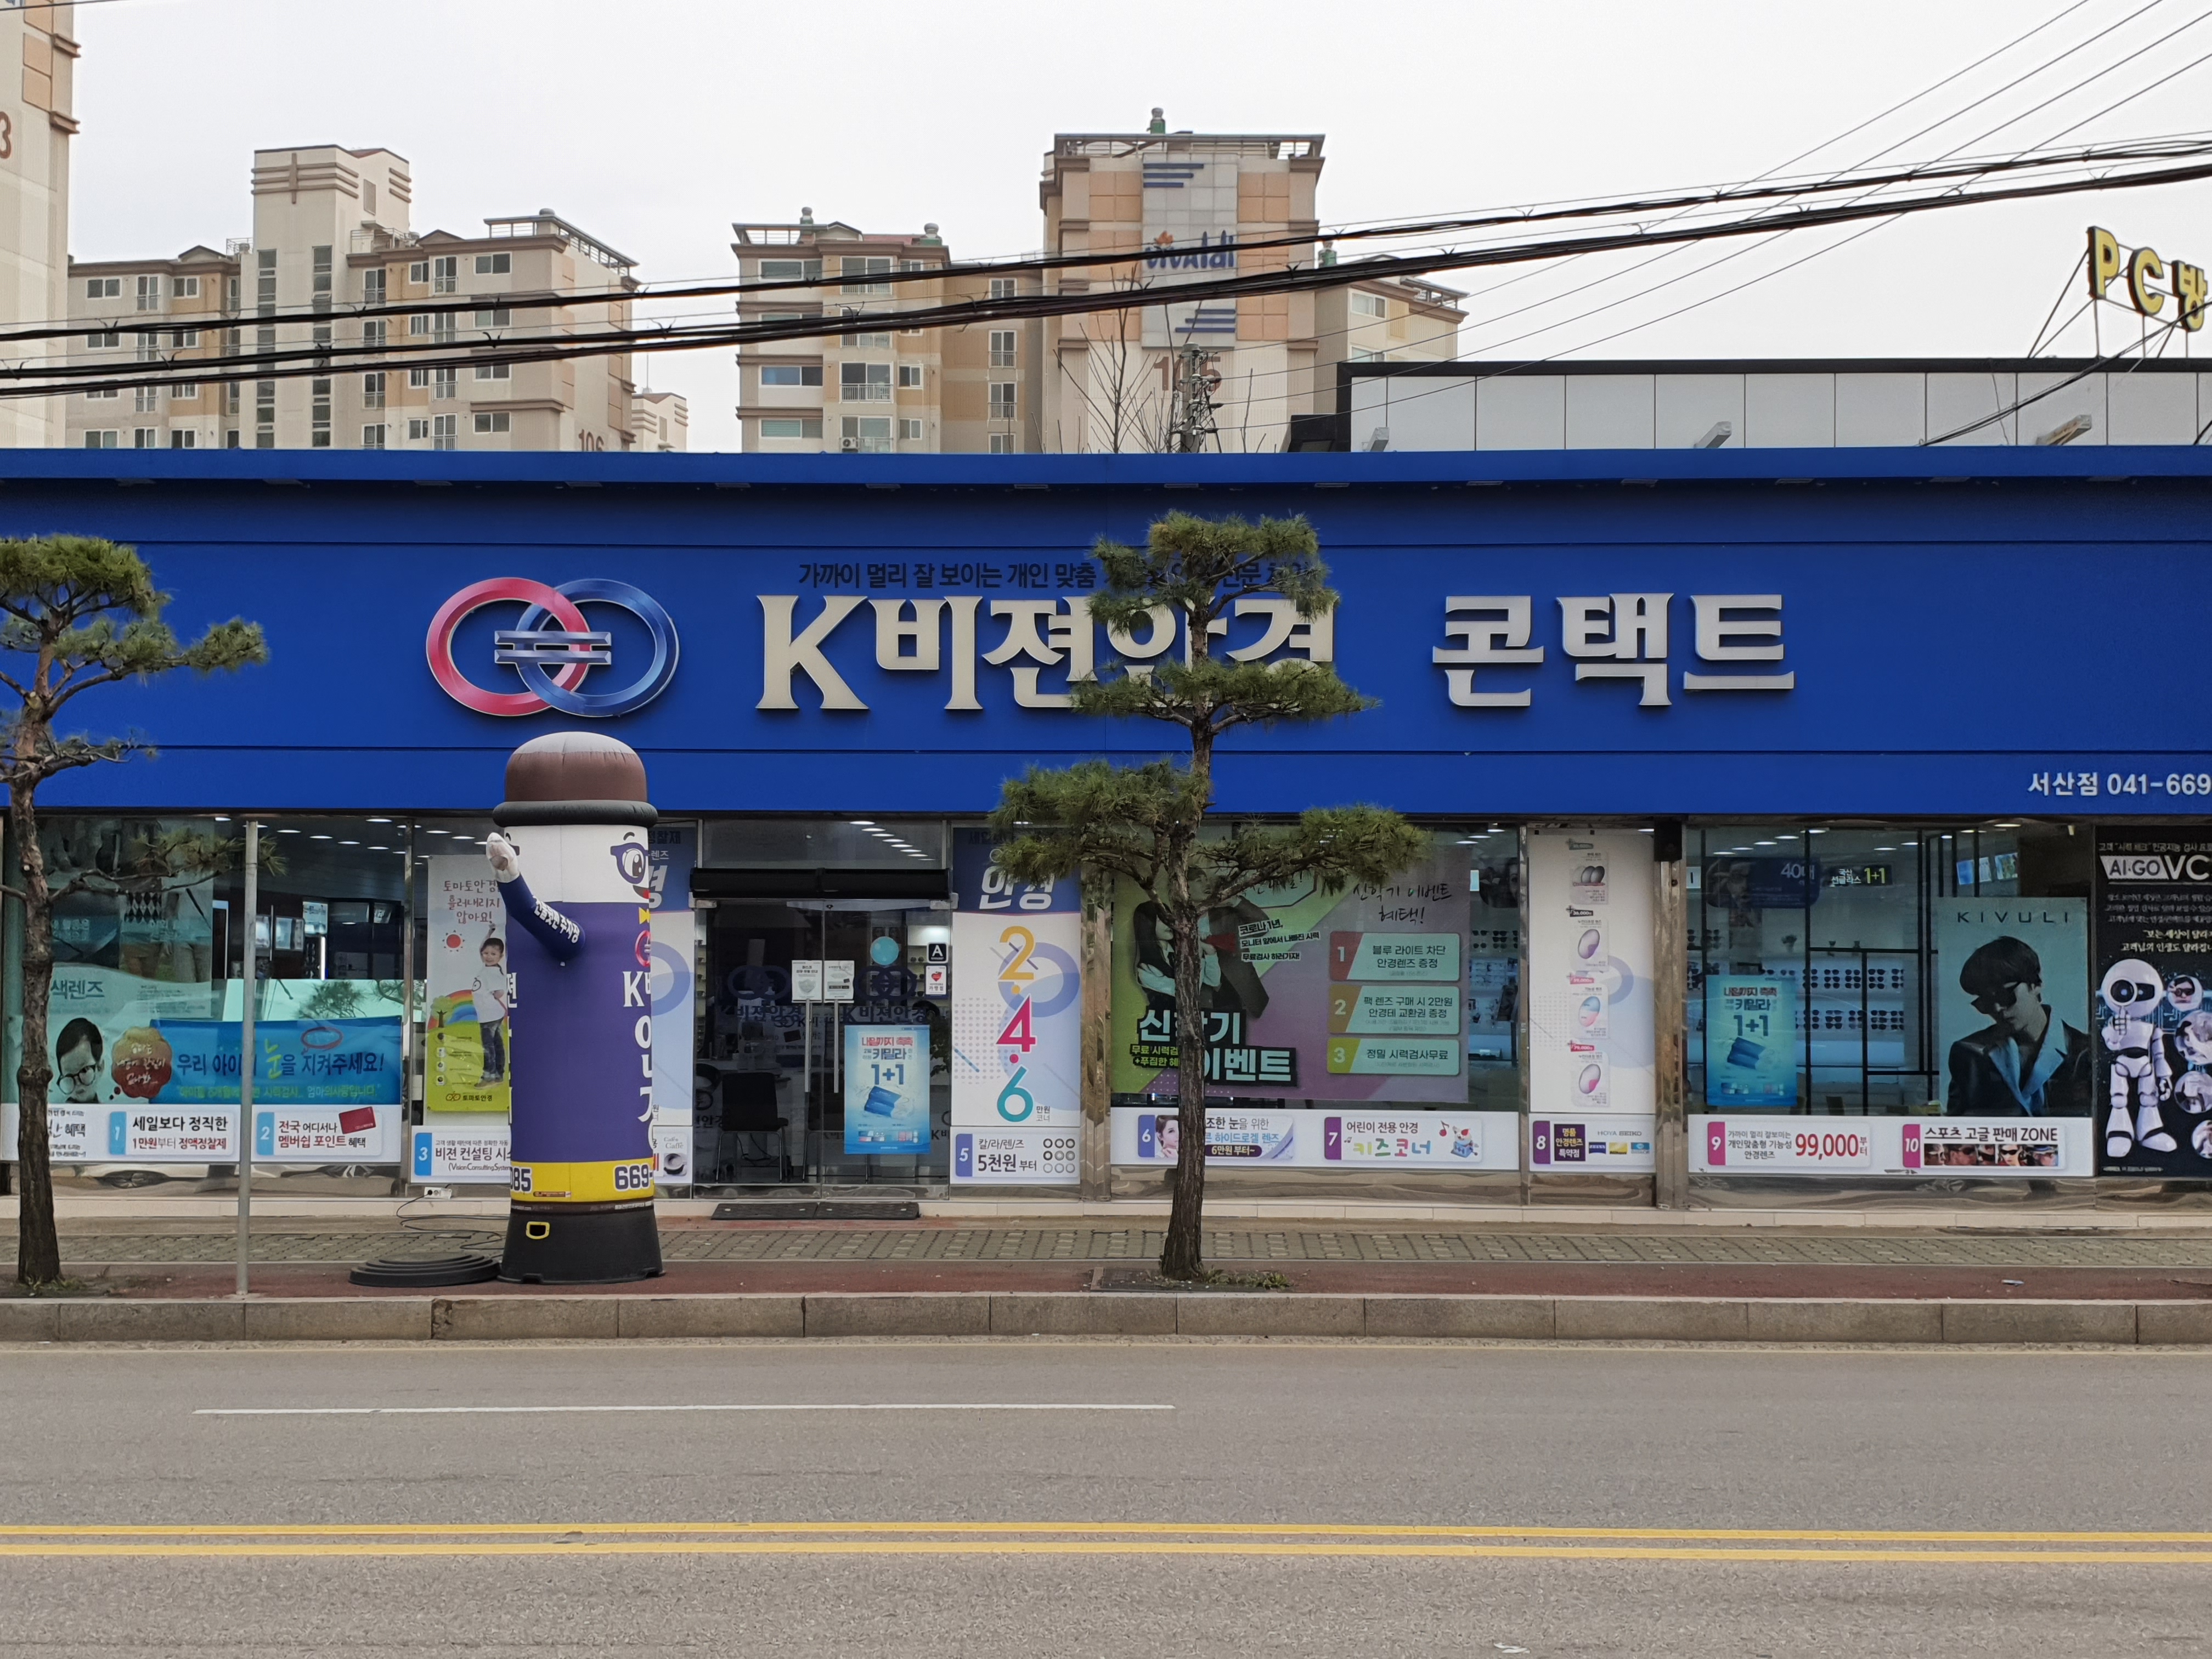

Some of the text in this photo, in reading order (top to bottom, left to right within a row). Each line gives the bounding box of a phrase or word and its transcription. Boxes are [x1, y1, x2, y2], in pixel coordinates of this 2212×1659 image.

[2086, 225, 2208, 332] PC방
[799, 563, 859, 588] 가까이
[867, 563, 907, 588] 멀리
[913, 563, 933, 588] 잘
[939, 563, 1002, 588] 보이는
[1007, 563, 1048, 588] 개인
[1054, 563, 1097, 588] 맞춤
[1432, 592, 1795, 707] 콘택트
[2028, 772, 2212, 796] 서산점 041-669
[1864, 867, 1885, 884] 1+1
[443, 879, 499, 894] 토마토안경
[1408, 883, 1452, 902] 이벤트
[448, 894, 499, 910] 흘러내리지
[1378, 905, 1425, 926] 혜택!
[1957, 911, 2068, 923] KIVULI
[1239, 922, 1266, 935] 코로나
[932, 945, 944, 957] A
[1241, 939, 1262, 947] 모니터
[1338, 945, 1446, 962] 1 블루 라이트 차단
[1377, 958, 1438, 968] 안경렌즈 증정
[1334, 999, 1346, 1015] 2
[1375, 997, 1393, 1006] 렌즈
[1396, 997, 1414, 1006] 구매
[1416, 997, 1425, 1006] 시
[1427, 997, 1453, 1007] 2만원
[1368, 1008, 1447, 1018] 안경테 교환권 증정
[1733, 1015, 1769, 1036] 1+1
[1132, 1045, 1178, 1056] 무료 시력검
[1333, 1047, 1448, 1063] 3 정밀 시력검사무료
[177, 1054, 206, 1076] 우리
[212, 1053, 257, 1076] 아이
[302, 1052, 385, 1076] 지켜주세요!
[1204, 1047, 1291, 1081] 이벤트
[871, 1064, 904, 1085] 1+1
[1036, 1105, 1051, 1114] 만원
[114, 1116, 228, 1141] 1 세일보다 정직한
[260, 1121, 337, 1140] 2 전국 어디서나
[1142, 1117, 1269, 1142] 6 조한 눈을 위한
[1328, 1121, 1419, 1146] 7 어린이 전용 안경
[132, 1138, 227, 1150] 1만원부터 정액정찰제
[278, 1135, 366, 1148] 멤버쉽 포인트 혜택
[1215, 1132, 1259, 1144] 하이드로겔
[1261, 1132, 1279, 1144] 렌즈
[1536, 1135, 1546, 1150] 8
[1555, 1138, 1583, 1147] 안경렌즈
[1711, 1136, 1722, 1150] 9
[1728, 1139, 1792, 1149] 개인맞춤형 기능성
[1905, 1127, 2058, 1152] 10 스포츠 고글 판매 ZONE
[418, 1147, 428, 1161] 3
[435, 1147, 457, 1161] 비젼
[460, 1147, 492, 1161] 컨설팅
[959, 1138, 1025, 1162] 5 칼/라/렌/즈
[1211, 1145, 1255, 1156] 6만원 부터~
[1353, 1138, 1431, 1157] 키즈코너
[1559, 1149, 1579, 1158] 특약점
[1745, 1150, 1776, 1160] 안경렌즈
[1795, 1133, 1859, 1161] 99,000
[978, 1154, 1037, 1172] 5천원 부터
